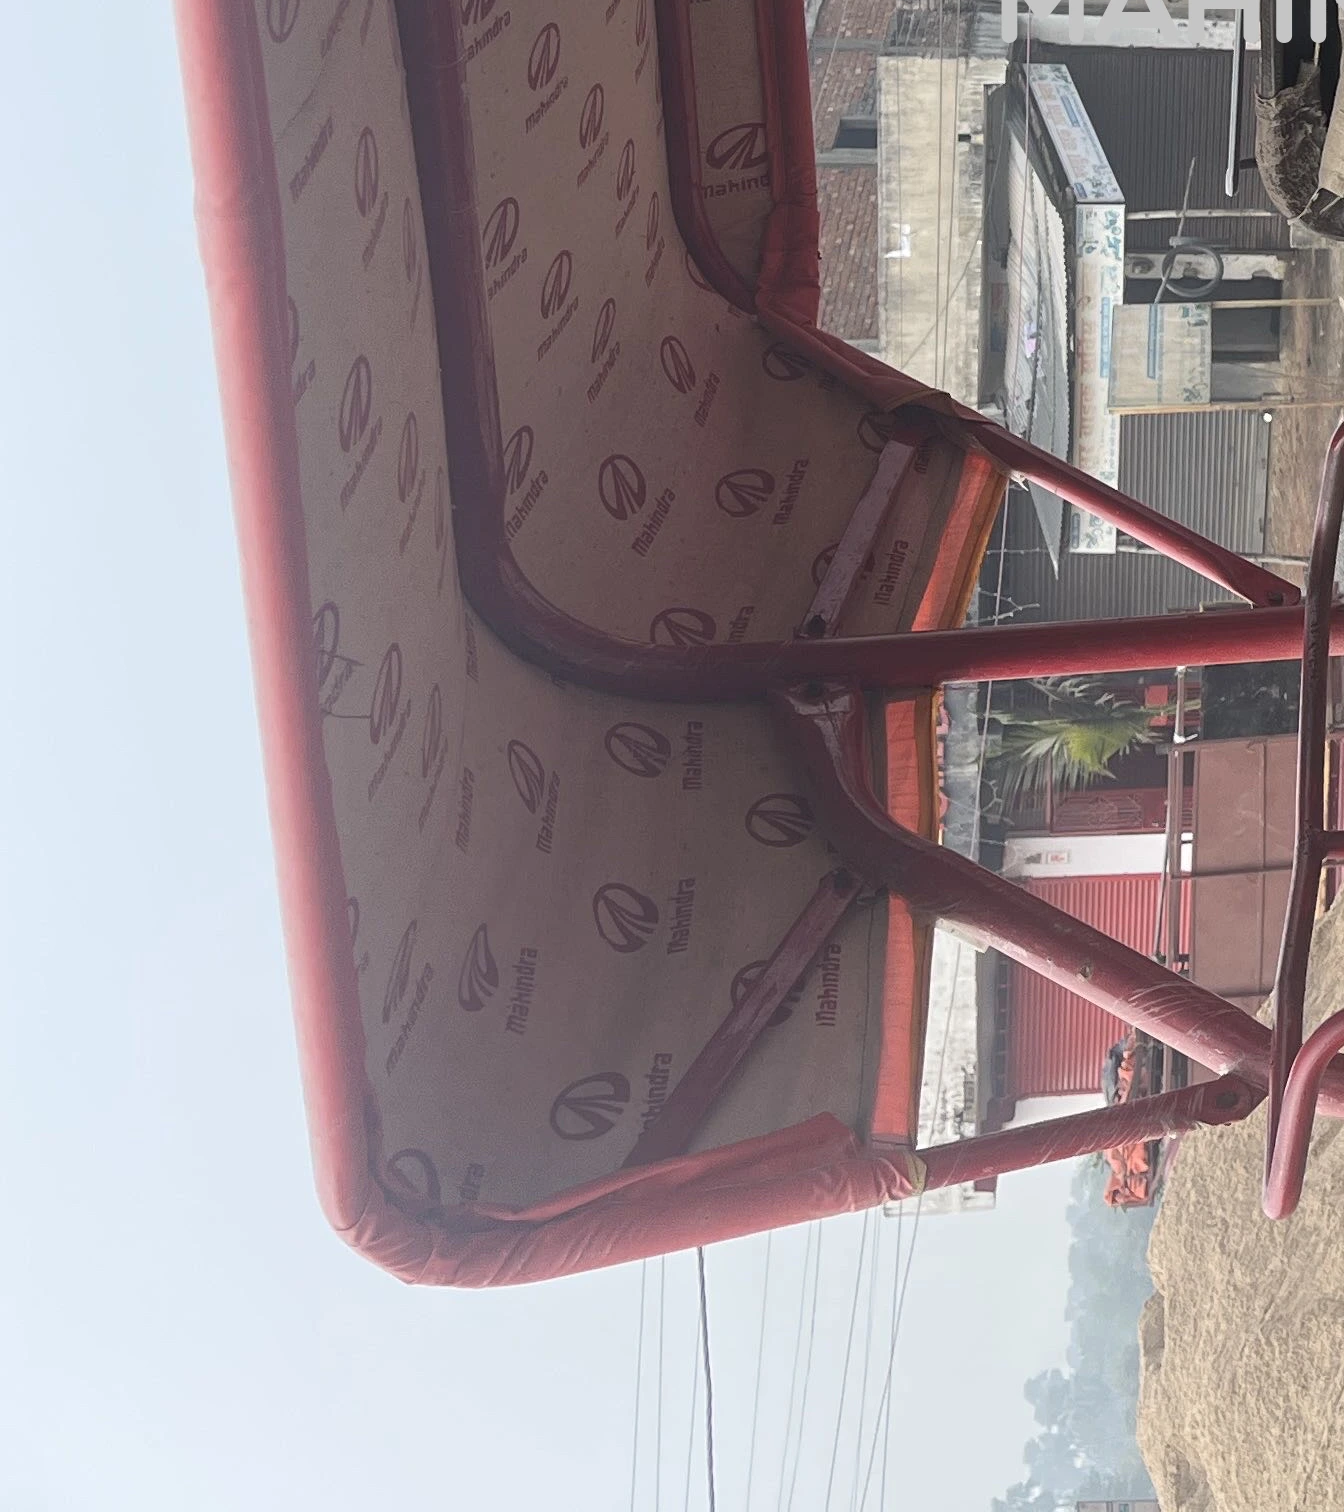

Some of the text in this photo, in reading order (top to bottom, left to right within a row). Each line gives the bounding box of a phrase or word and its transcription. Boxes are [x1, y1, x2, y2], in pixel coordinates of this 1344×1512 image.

[632, 488, 676, 557] Mahindra
[773, 459, 809, 525] Mahindra
[873, 539, 909, 606] Mahindra
[682, 721, 703, 790] Mahindra
[667, 877, 696, 955] Mahindra
